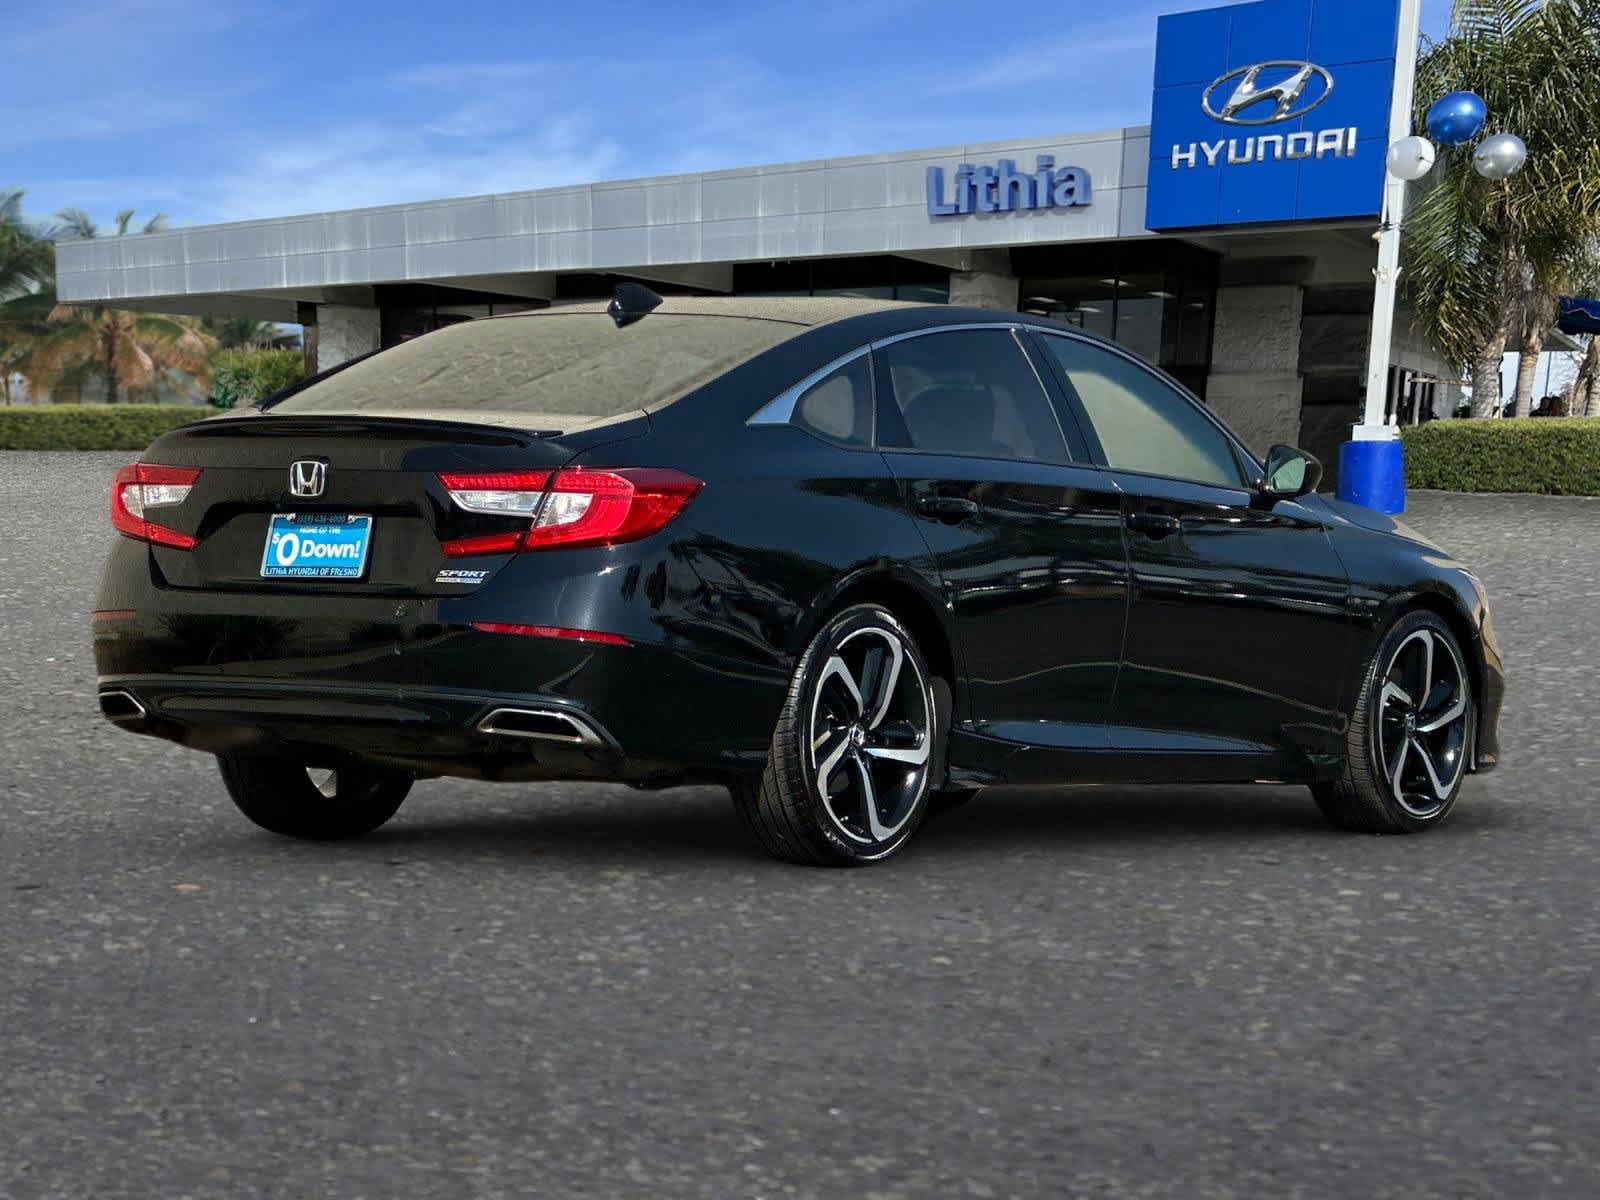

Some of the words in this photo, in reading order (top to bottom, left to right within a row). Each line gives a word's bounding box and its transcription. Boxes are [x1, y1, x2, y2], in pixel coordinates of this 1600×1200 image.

[1171, 127, 1357, 169] HYUNDAI
[925, 155, 1092, 216] Lithia
[300, 539, 361, 559] Down!
[265, 567, 288, 576] LITHIA
[288, 567, 319, 576] HYUNDAI
[319, 567, 330, 576] OF
[330, 567, 358, 577] FRESNO
[437, 569, 490, 578] SPORT
